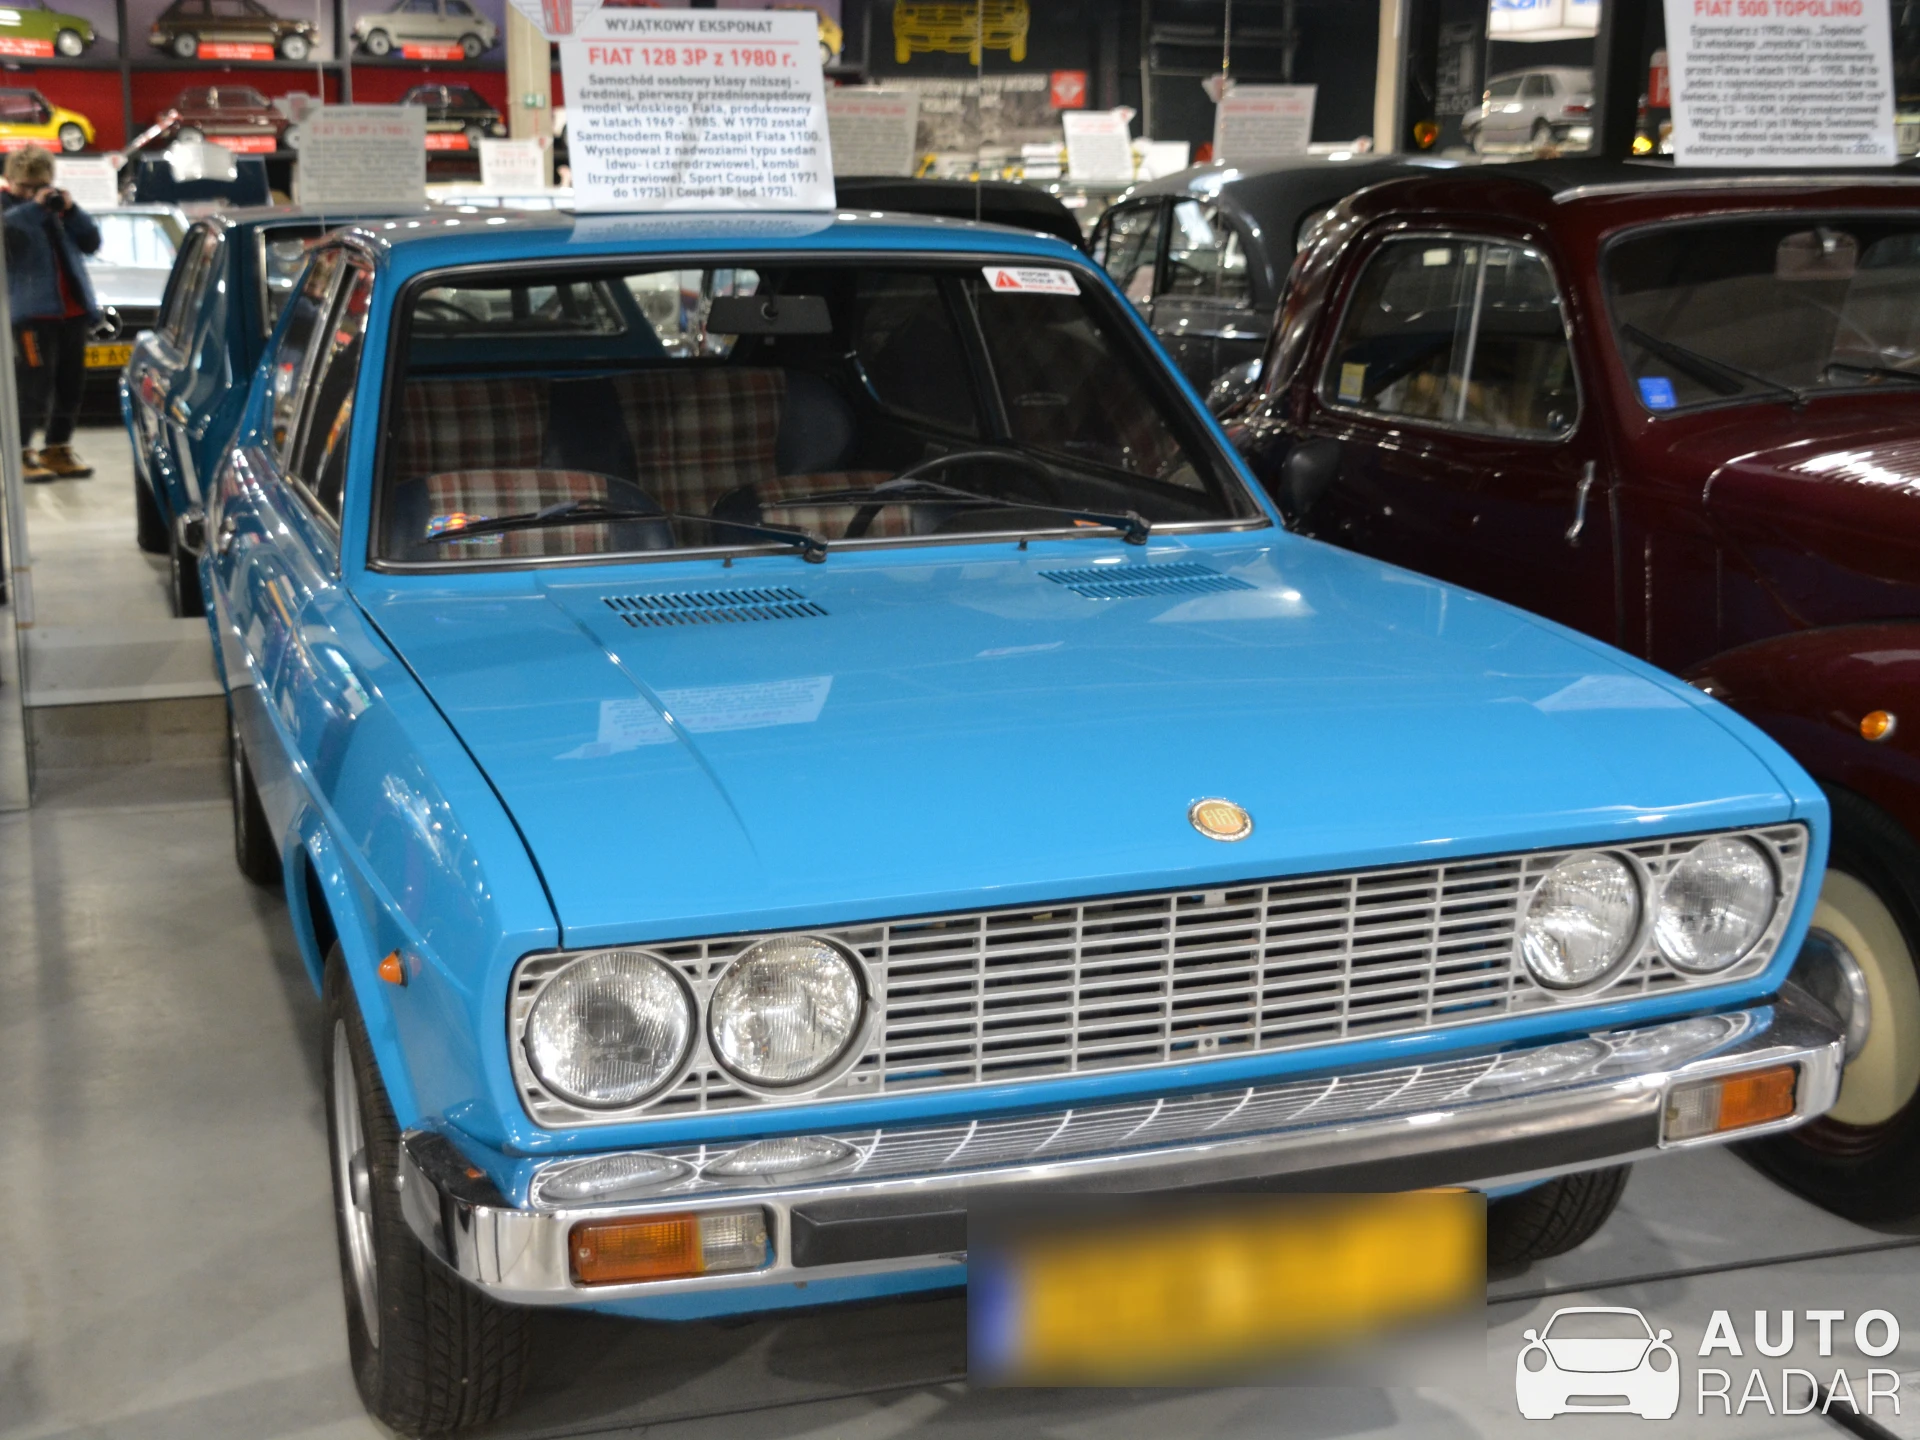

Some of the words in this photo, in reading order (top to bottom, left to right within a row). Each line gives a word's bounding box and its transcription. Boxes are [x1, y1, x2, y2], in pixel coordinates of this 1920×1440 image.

[1694, 0, 1732, 16] FIAT
[1738, 0, 1768, 17] 500
[1773, 0, 1864, 17] TOPOLINO
[605, 18, 694, 34] WYJĄTKOWY
[699, 19, 773, 33] EKSPONAT
[588, 47, 634, 66] FIAT
[641, 47, 677, 66] 128
[682, 48, 708, 66] 3P
[730, 48, 776, 67] 1980
[782, 53, 797, 67] r.
[588, 74, 654, 86] Samochód
[658, 75, 710, 88] osobowy
[714, 75, 746, 89] klasy
[750, 76, 791, 89] niższej
[580, 88, 635, 102] średniej,
[638, 88, 694, 102] pierwszy
[698, 90, 812, 103] przednionapędowy
[582, 103, 620, 114] model
[626, 103, 688, 116] włoskiego
[692, 103, 726, 115] Fiata,
[730, 104, 811, 117] produkowany
[603, 117, 641, 128] latach
[646, 117, 674, 128] 1969
[688, 117, 720, 128] 1985.
[724, 118, 735, 128] W
[740, 118, 768, 128] 1970
[772, 118, 807, 128] został
[577, 131, 662, 142] Samochodem
[666, 132, 698, 142] Roku.
[704, 131, 752, 143] Zastąpił
[756, 131, 786, 142] Fiata
[790, 131, 822, 142] 1100.
[585, 145, 661, 158] Występował
[674, 145, 748, 156] nadwoziami
[750, 146, 777, 158] typu
[780, 145, 817, 156] sedan
[606, 158, 642, 170] (dwu-
[653, 158, 759, 170] czterodrzwiowe),
[762, 158, 799, 170] kombi
[588, 172, 686, 186] (trzydrzwiowe),
[690, 172, 722, 185] Sport
[726, 172, 764, 185] Coupé
[768, 172, 786, 184] (od
[791, 172, 818, 183] 1971
[614, 187, 628, 198] do
[632, 187, 666, 199] 1975)
[676, 186, 714, 200] Coupé
[718, 186, 734, 198] 3P
[738, 186, 757, 198] (od
[761, 186, 797, 198] 1975).
[1201, 807, 1240, 827] FIAT
